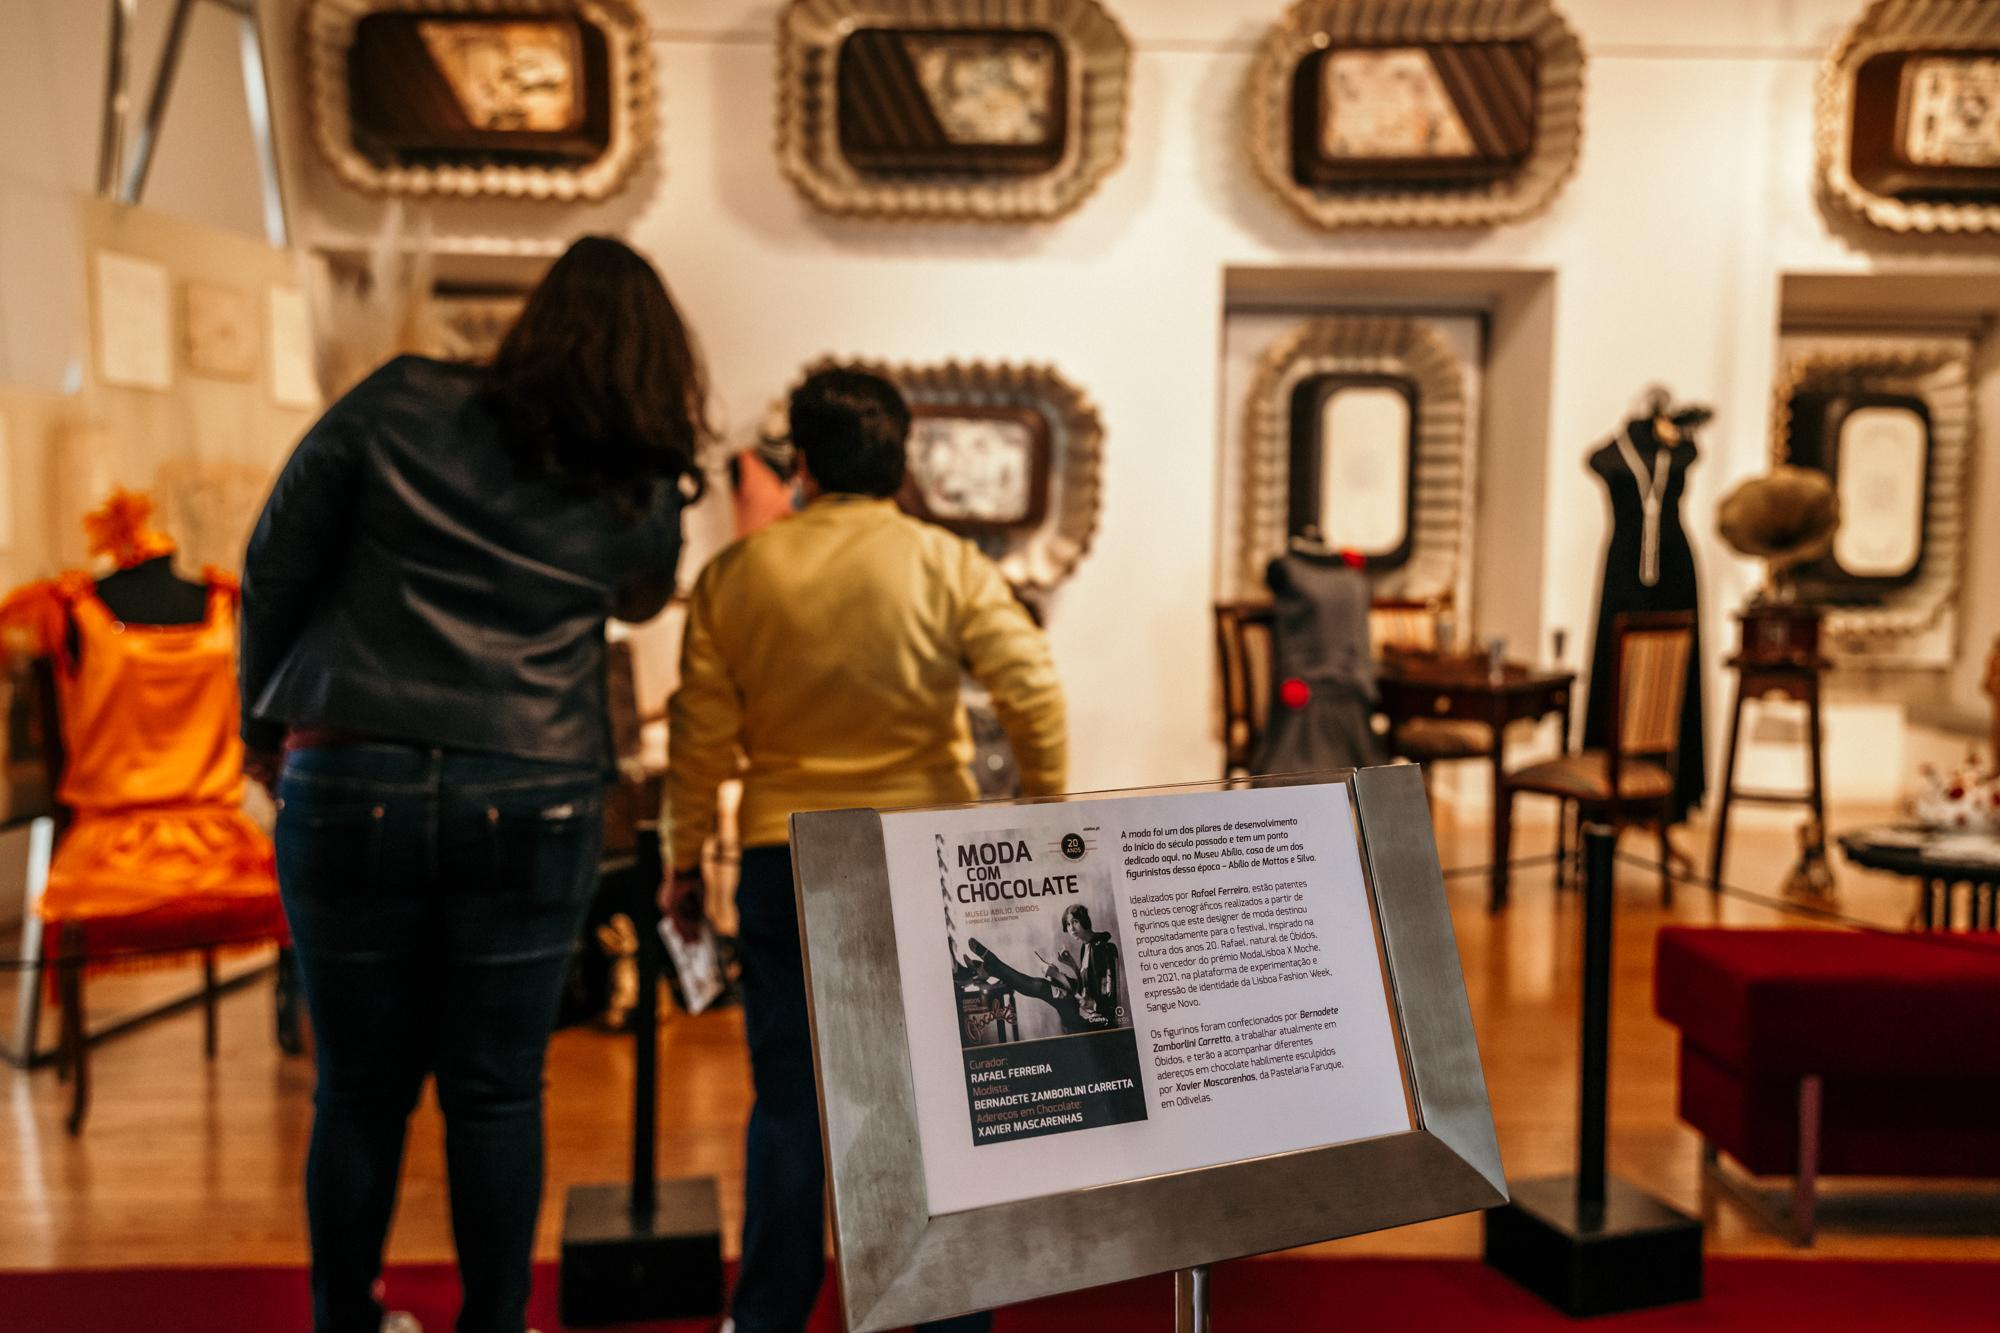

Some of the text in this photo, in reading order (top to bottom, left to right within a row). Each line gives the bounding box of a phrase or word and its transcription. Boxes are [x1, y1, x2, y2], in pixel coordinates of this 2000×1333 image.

[1120, 817, 1298, 839] A moda foi um dos pilares de desenvolvimento
[958, 840, 1032, 867] MODA
[1067, 838, 1078, 847] 20
[1122, 842, 1132, 852] do
[1134, 841, 1154, 852] início
[1156, 840, 1166, 850] do
[1168, 838, 1194, 848] século
[1195, 834, 1228, 849] passado
[1229, 836, 1234, 844] e
[1266, 831, 1288, 842] ponto
[1124, 854, 1160, 866] dedicado
[1161, 852, 1180, 864] aqui,
[1194, 850, 1219, 860] Museu
[1220, 847, 1244, 857] Abílio,
[1246, 847, 1264, 855] casa
[1265, 844, 1275, 854] de
[1290, 842, 1304, 851] dos
[966, 866, 1001, 881] COM
[1126, 868, 1171, 880] figurinistas
[1172, 865, 1196, 874] dessa
[1197, 863, 1220, 874] época
[1228, 859, 1249, 869] Abílio
[1250, 858, 1260, 867] de
[1262, 857, 1289, 866] Mattos
[957, 875, 1079, 903] CHOCOLATE
[1175, 892, 1189, 902] por
[1191, 887, 1217, 898] Rafael
[1252, 883, 1273, 892] estão
[1274, 881, 1307, 893] patentes
[1132, 908, 1138, 918] 8
[1139, 906, 1171, 917] núcleos
[1172, 901, 1223, 914] cenográficos
[1224, 897, 1263, 908] realizados
[1270, 894, 1292, 906] partir
[1294, 892, 1303, 901] de
[1134, 906, 1307, 933] figurinos que este designer de moda destinou
[1136, 929, 1208, 946] propositadamente
[1210, 928, 1228, 939] para
[1268, 918, 1303, 931] inspirado
[1304, 918, 1314, 926] na
[1138, 947, 1167, 958] cultura
[1168, 945, 1184, 955] dos
[1185, 944, 1204, 952] anos
[1249, 934, 1278, 946] natural
[1278, 933, 1289, 942] de
[1139, 962, 1151, 971] foi
[1152, 962, 1158, 970] o
[1159, 957, 1196, 969] vencedor
[1198, 955, 1209, 964] do
[1210, 952, 1238, 966] prémio
[1286, 946, 1292, 954] X
[1142, 976, 1156, 985] em
[1181, 972, 1191, 980] na
[1192, 967, 1237, 981] plataforma
[1238, 964, 1248, 974] de
[1250, 957, 1312, 974] experimentação
[1144, 986, 1186, 1000] expressão
[1187, 984, 1198, 993] de
[1199, 978, 1239, 991] identidade
[1240, 977, 1251, 986] da
[1252, 975, 1278, 985] Lisboa
[1278, 969, 1308, 982] Fashion
[1146, 1002, 1176, 1013] Sangue
[1150, 1006, 1339, 1039] Os figurinos foram confecionados por Bernadete
[1152, 1038, 1196, 1053] Zamborlini
[1234, 1034, 1240, 1042] a
[1241, 1028, 1277, 1040] trabalhar
[1279, 1022, 1322, 1035] atualmente
[1324, 1021, 1337, 1029] em
[1193, 1050, 1215, 1061] terão
[1217, 1050, 1222, 1058] a
[1224, 1043, 1272, 1057] acompanhar
[1274, 1038, 1313, 1050] diferentes
[971, 1064, 1052, 1084] RAFAEL FERREIRA
[1157, 1047, 1336, 1080] adereços em chocolate habilmente esculpidos
[1159, 1085, 1173, 1097] por
[1176, 1080, 1201, 1092] Xavier
[1259, 1069, 1270, 1080] da
[1270, 1065, 1309, 1078] Pastelaria
[974, 1078, 1134, 1110] BERNADETE ZAMBORLINI CARRETTA
[1161, 1100, 1175, 1109] em
[1021, 1108, 1035, 1116] em
[978, 1113, 1083, 1137] XAVIER MASCARENHAS
